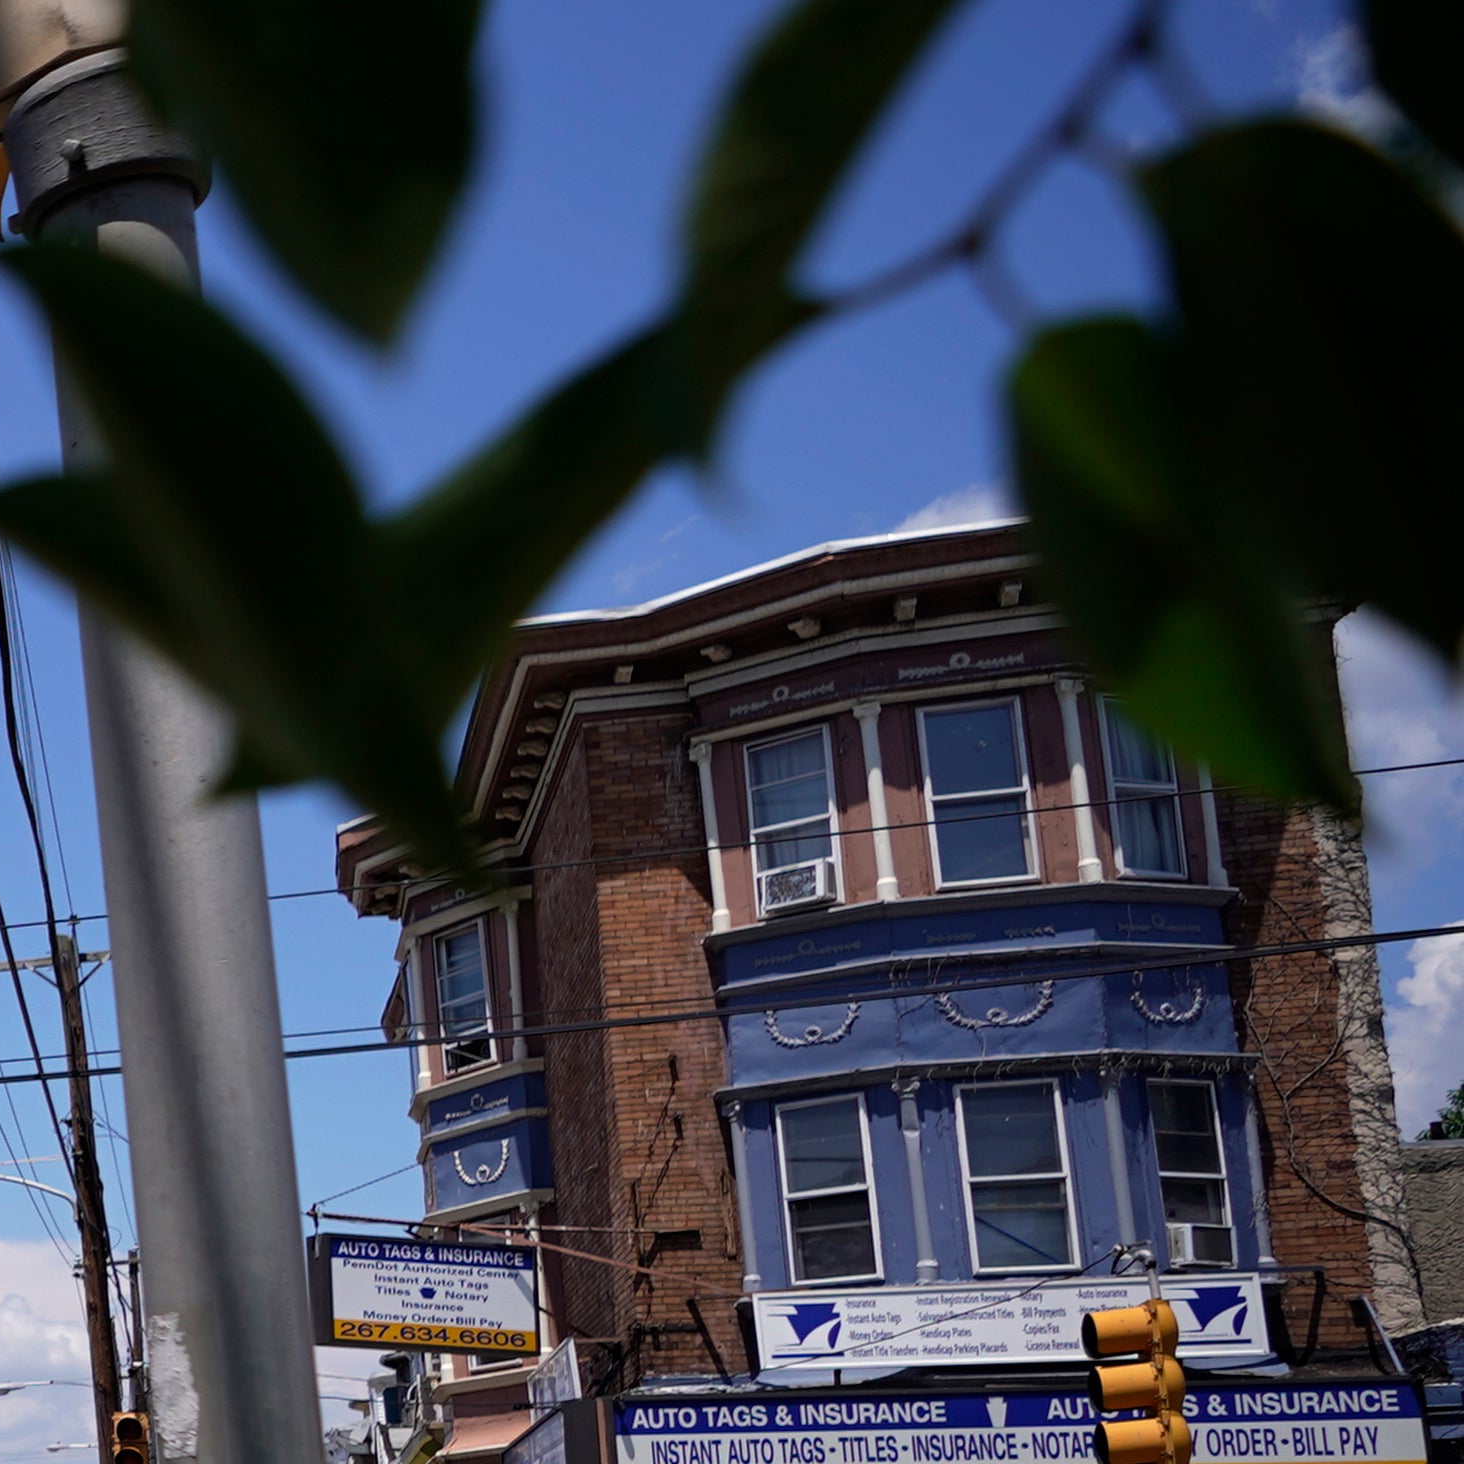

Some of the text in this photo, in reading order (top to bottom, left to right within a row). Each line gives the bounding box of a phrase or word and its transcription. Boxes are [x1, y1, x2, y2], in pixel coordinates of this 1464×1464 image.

[338, 1242, 524, 1267] AUTO TAGS & INSURANCE
[343, 1259, 520, 1280] PennDot Authorized Center
[374, 1274, 489, 1290] Instant Auto Tags
[375, 1286, 489, 1303] Titles Notary
[1095, 1288, 1127, 1298] Insurance
[401, 1300, 464, 1312] Insurance
[1033, 1306, 1066, 1319] Payments
[362, 1310, 407, 1323] Money
[479, 1318, 503, 1329] Pay
[872, 1314, 886, 1323] Auto
[886, 1313, 902, 1326] Tags
[340, 1322, 526, 1348] 267.634.6606
[952, 1327, 972, 1338] Plates
[1207, 1394, 1228, 1416] &
[1235, 1389, 1400, 1416] INSURANCE
[632, 1401, 947, 1429] AUTO TAGS & INSURANCE
[778, 1437, 825, 1464] TAGS
[838, 1435, 899, 1463] TITLES
[911, 1432, 1017, 1462] INSURANCE
[1031, 1431, 1095, 1460] NOTAR
[1206, 1428, 1279, 1457] ORDER
[1292, 1426, 1334, 1456] BILL
[1339, 1426, 1379, 1456] PAY
